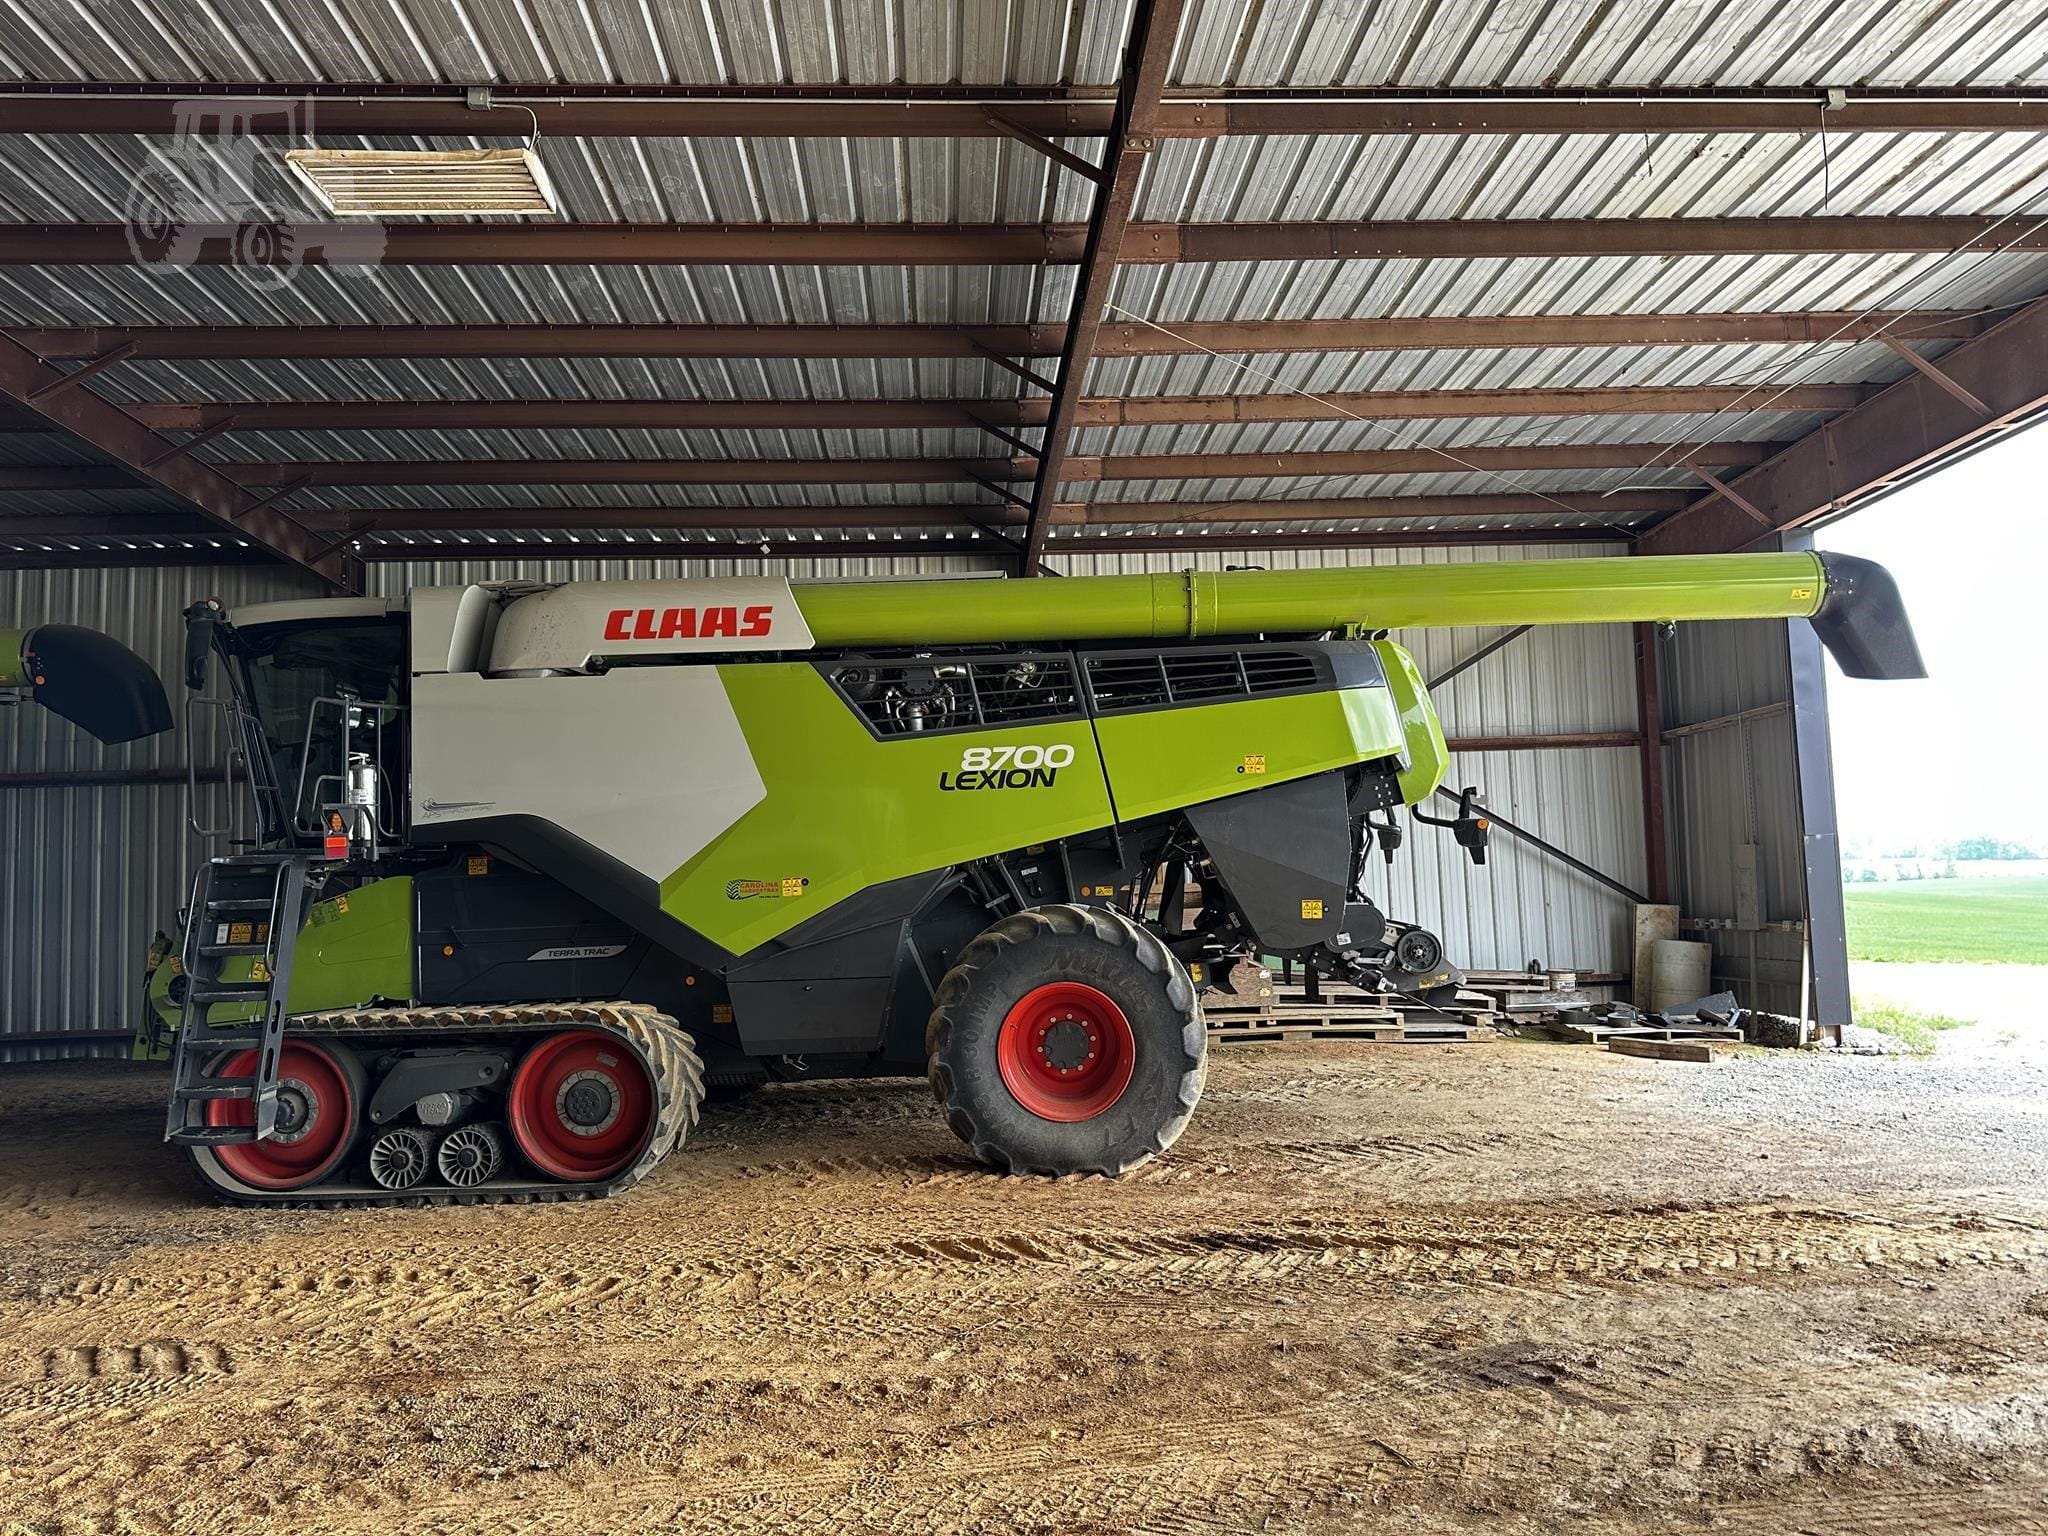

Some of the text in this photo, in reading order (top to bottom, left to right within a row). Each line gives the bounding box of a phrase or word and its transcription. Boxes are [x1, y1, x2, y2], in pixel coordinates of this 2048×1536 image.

[604, 606, 773, 640] CLAAS
[961, 745, 1075, 771] 8700
[940, 768, 1057, 791] LEXION
[547, 948, 610, 958] TERRA TRAC
[961, 1029, 980, 1060] 30
